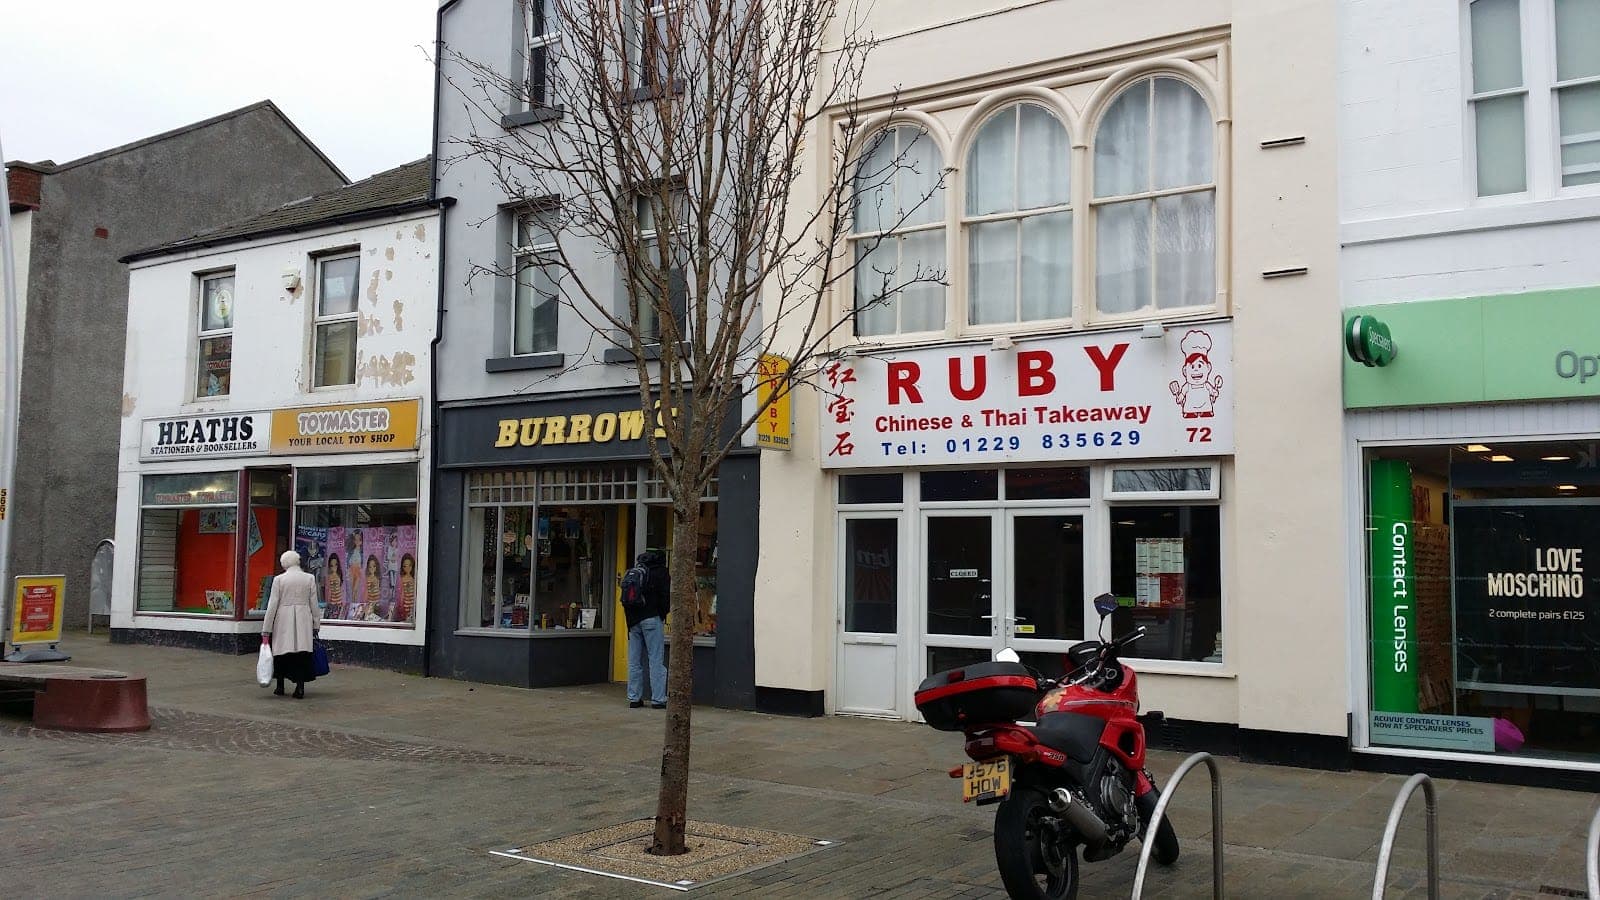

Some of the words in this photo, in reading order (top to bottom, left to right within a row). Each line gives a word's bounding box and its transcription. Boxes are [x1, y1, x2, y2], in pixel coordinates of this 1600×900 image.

[888, 343, 1130, 405] RUBY
[298, 408, 389, 435] TOYMASTER
[825, 362, 857, 456] 红宝石
[875, 415, 953, 432] Chinese
[961, 414, 973, 428] &
[981, 407, 1027, 427] Thai
[1034, 405, 1151, 424] Takeaway
[157, 416, 253, 446] HEATHS
[288, 437, 312, 447] YOUR
[316, 436, 344, 446] LOCAL
[349, 435, 366, 444] TOY
[370, 433, 395, 443] SHOP
[881, 441, 926, 456] Tel:
[946, 436, 1020, 453] 01229
[1042, 430, 1141, 449] 835629
[1186, 427, 1211, 442] 72
[150, 445, 195, 455] STATIONERS
[196, 444, 203, 453] &
[204, 441, 257, 453] BOOKSELLERS
[1392, 522, 1408, 597] Contact
[1536, 547, 1584, 572] LOVE
[1487, 573, 1584, 598] MOSCHINO
[1489, 609, 1495, 618] 2
[1496, 610, 1537, 620] complete
[1539, 610, 1561, 620] pairs
[1563, 611, 1585, 620] £125
[1393, 605, 1409, 673] Lenses
[1374, 715, 1404, 723] ACUVUE
[1406, 717, 1440, 726] CONTACT
[1442, 719, 1471, 727] LENSES
[970, 776, 1002, 796] HOW
